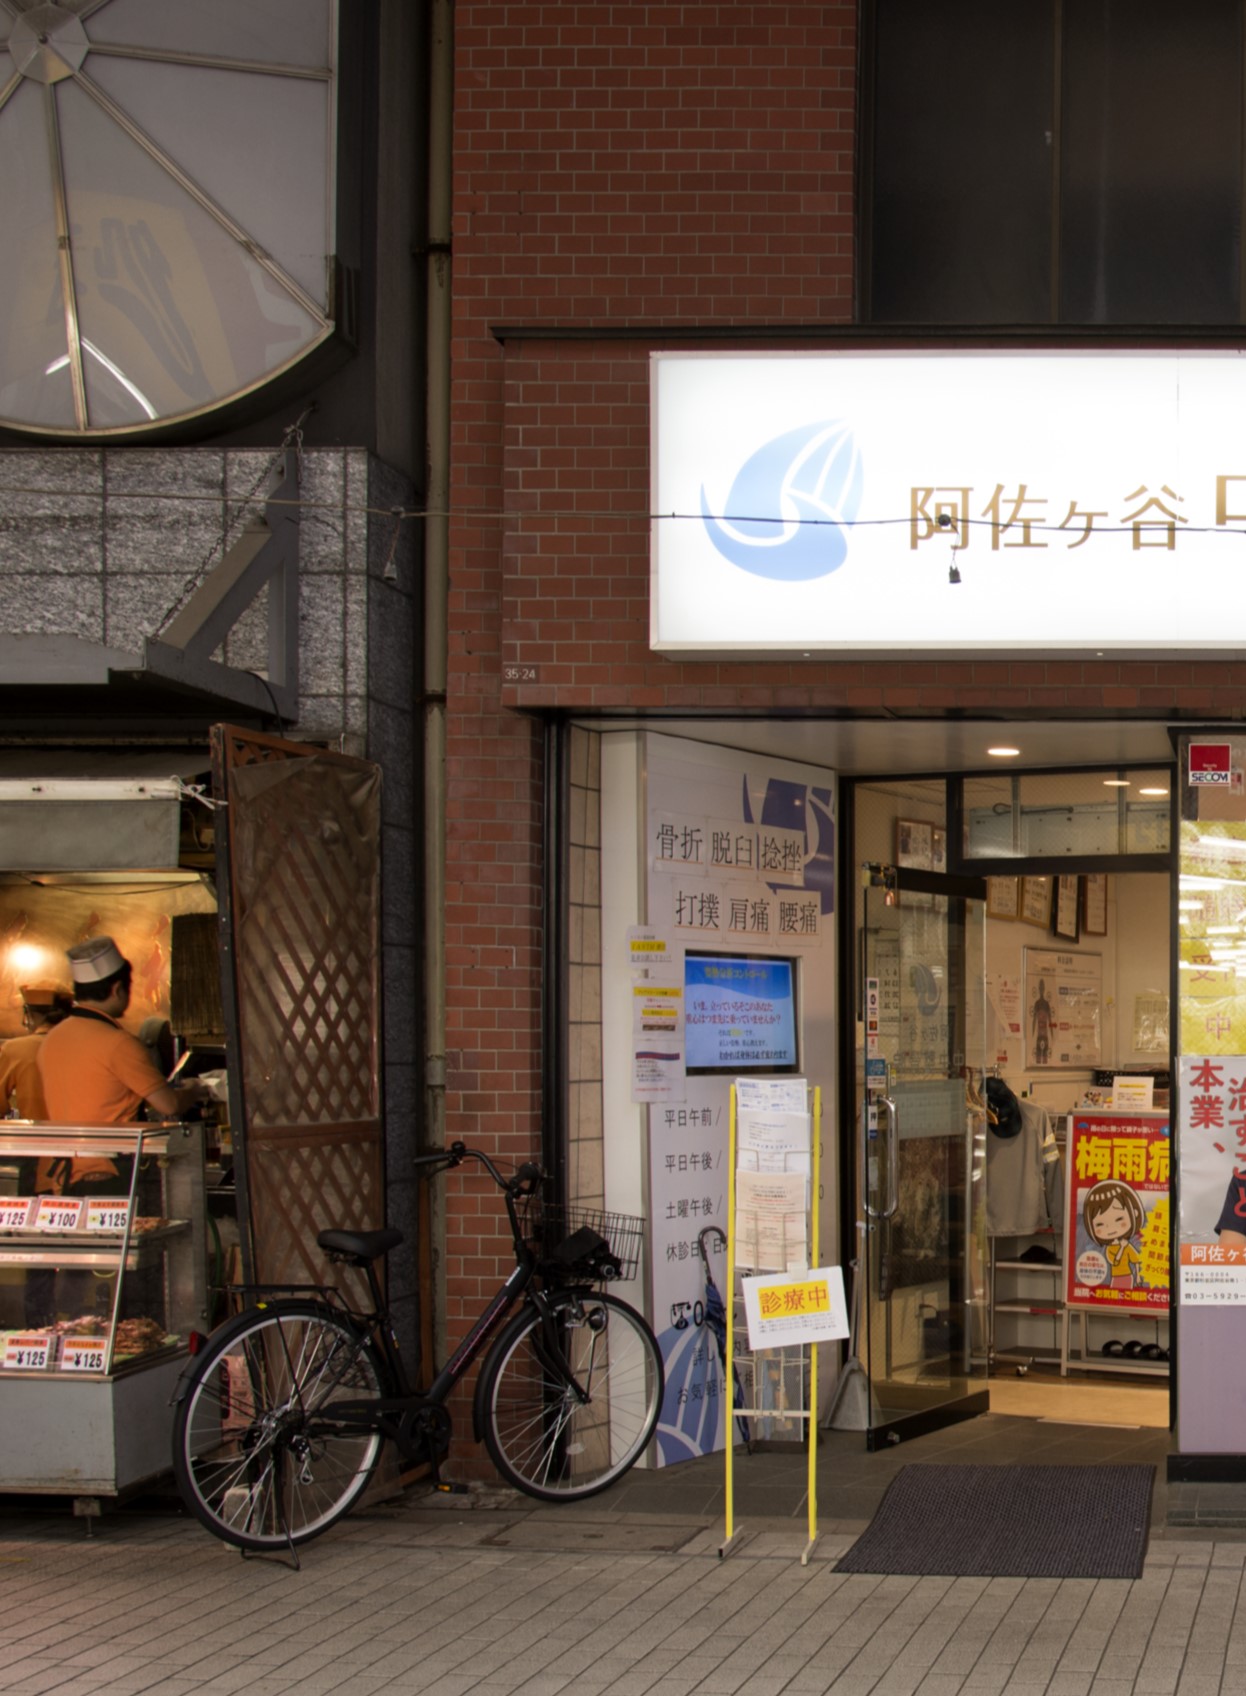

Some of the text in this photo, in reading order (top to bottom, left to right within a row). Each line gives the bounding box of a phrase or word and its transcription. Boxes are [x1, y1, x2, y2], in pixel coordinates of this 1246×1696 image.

[1191, 772, 1229, 782] SECOM
[656, 823, 801, 872] 骨折 脱臼 捻挫
[675, 891, 817, 934] 打撲 肩痛 腰痛
[100, 1211, 127, 1228] ¥125
[760, 1286, 827, 1314] 診療中
[17, 1350, 46, 1367] ¥125
[74, 1352, 103, 1368] ¥125
